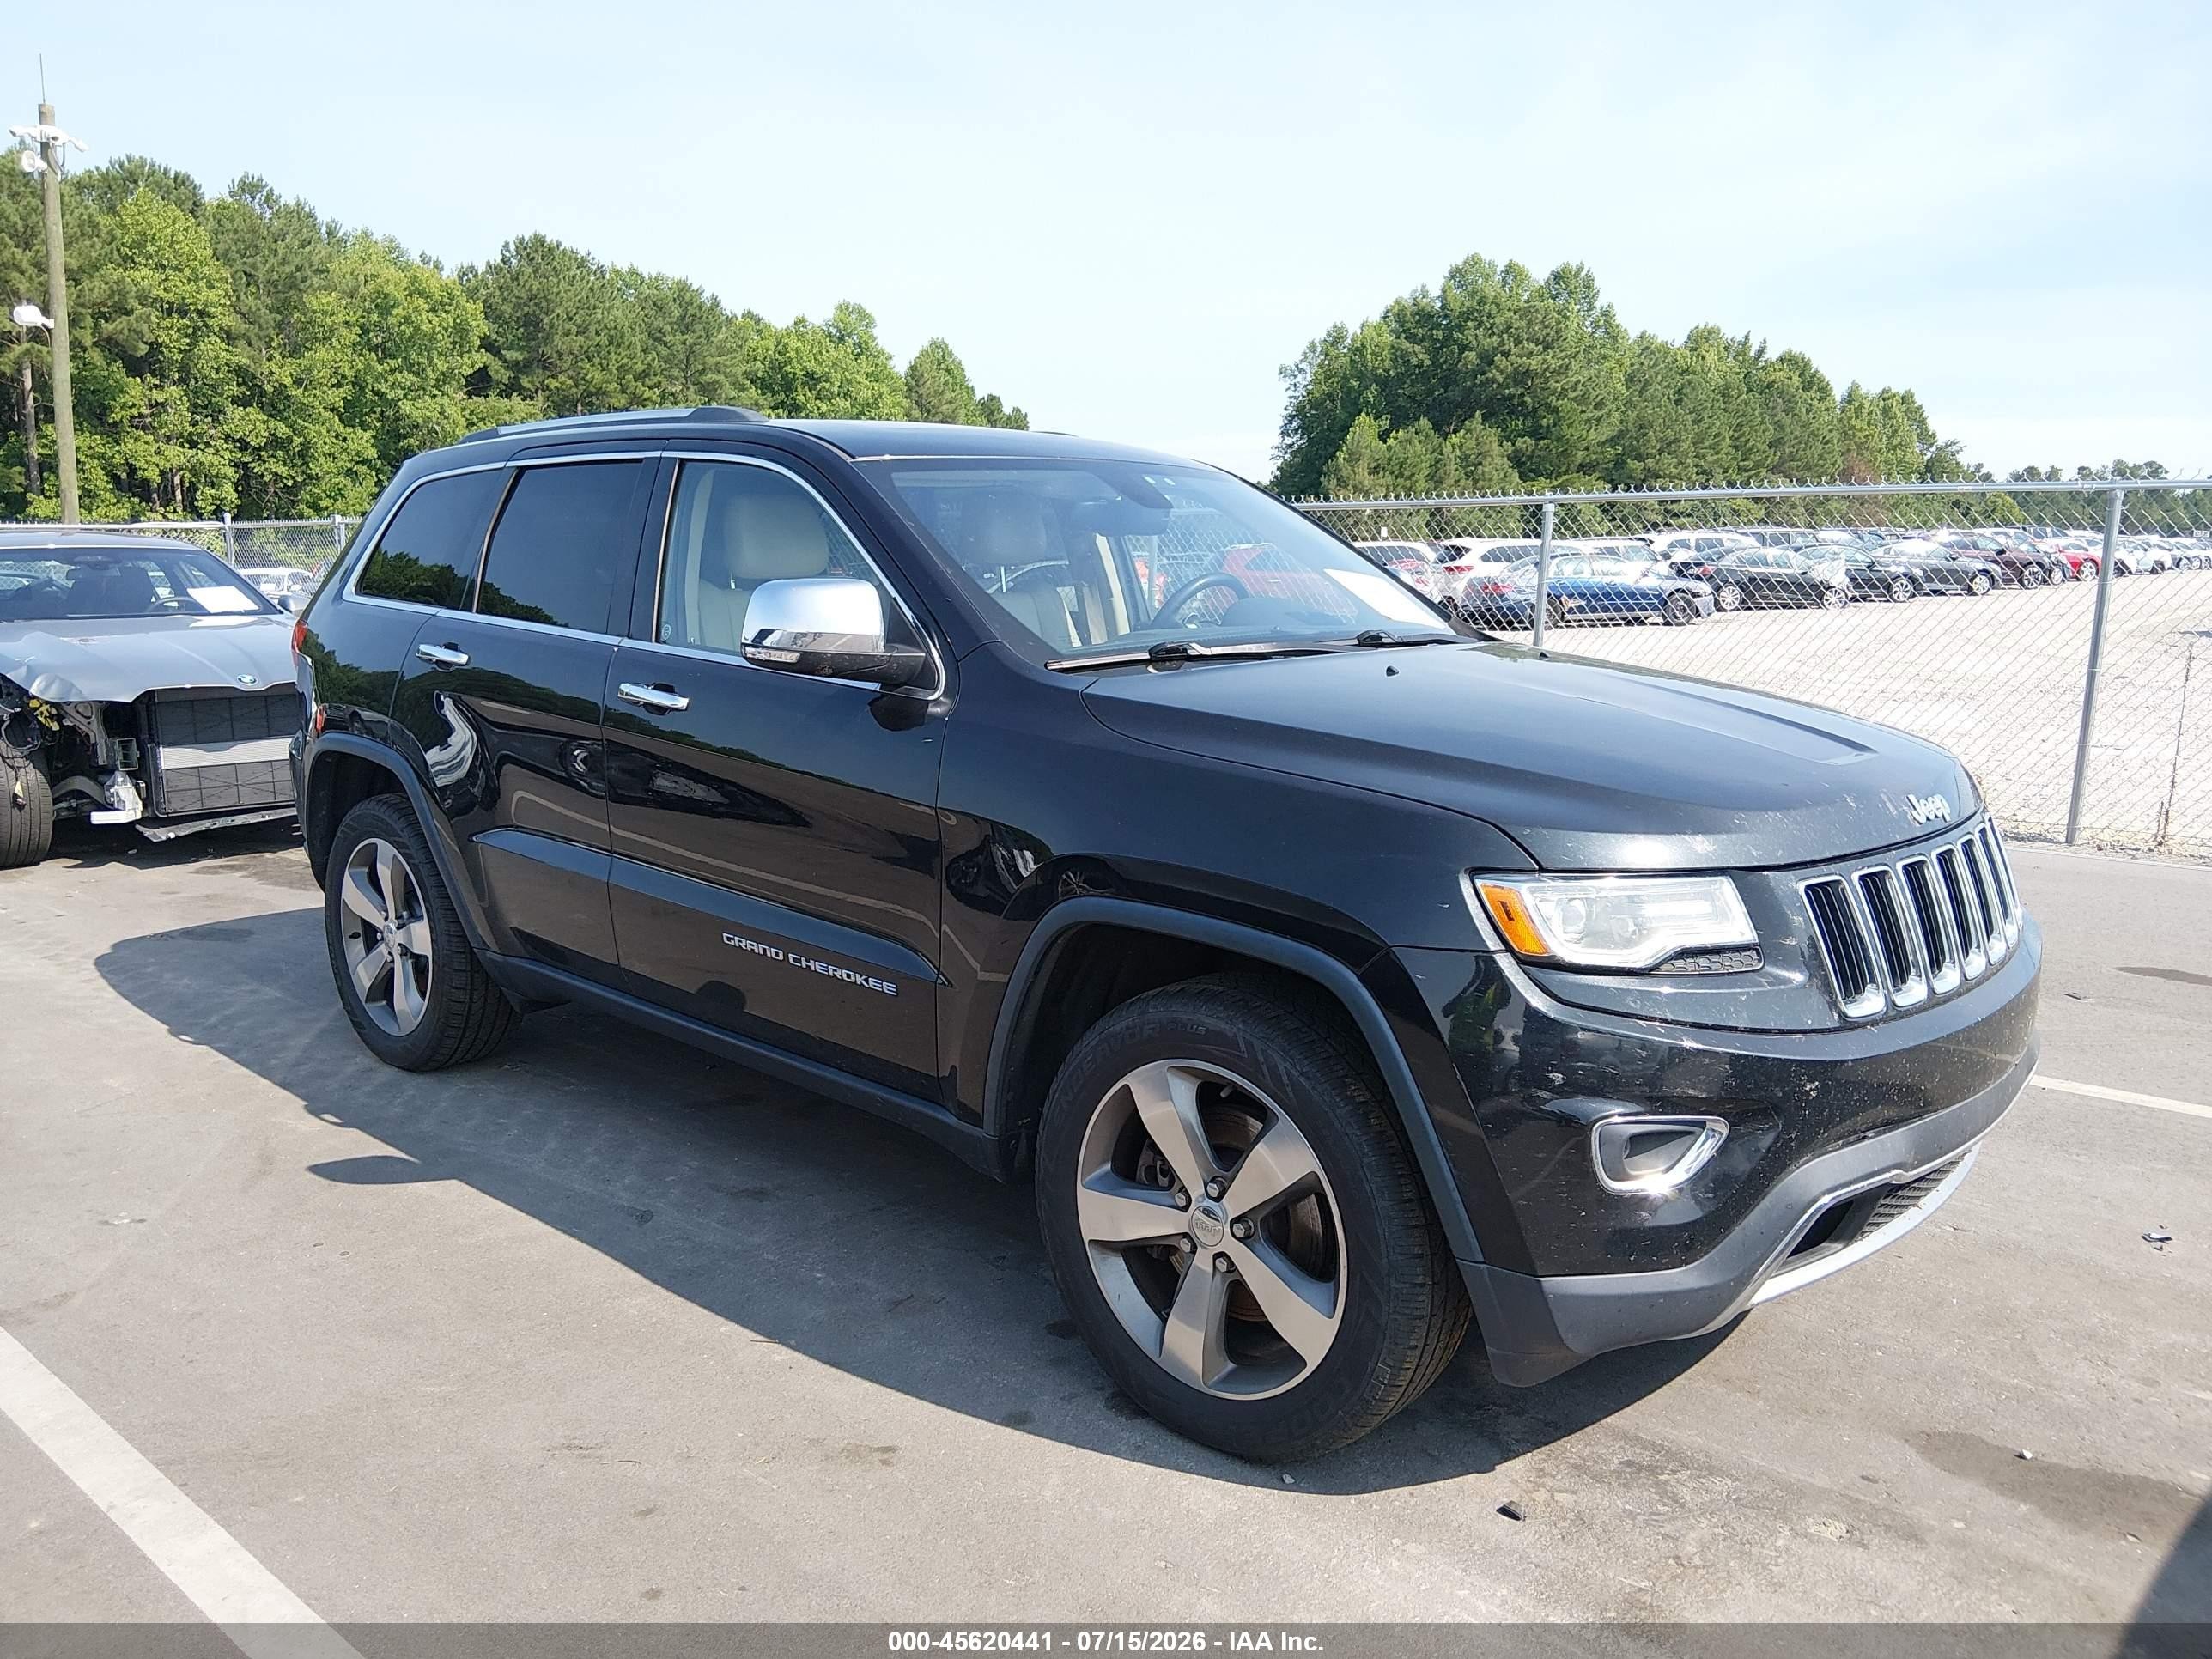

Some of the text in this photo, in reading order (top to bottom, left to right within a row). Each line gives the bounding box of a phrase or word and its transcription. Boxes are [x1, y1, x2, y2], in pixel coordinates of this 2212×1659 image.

[1905, 793, 1951, 824] Jeep
[722, 932, 898, 997] GRAND CHEROKEE
[1166, 1021, 1208, 1036] PLUS
